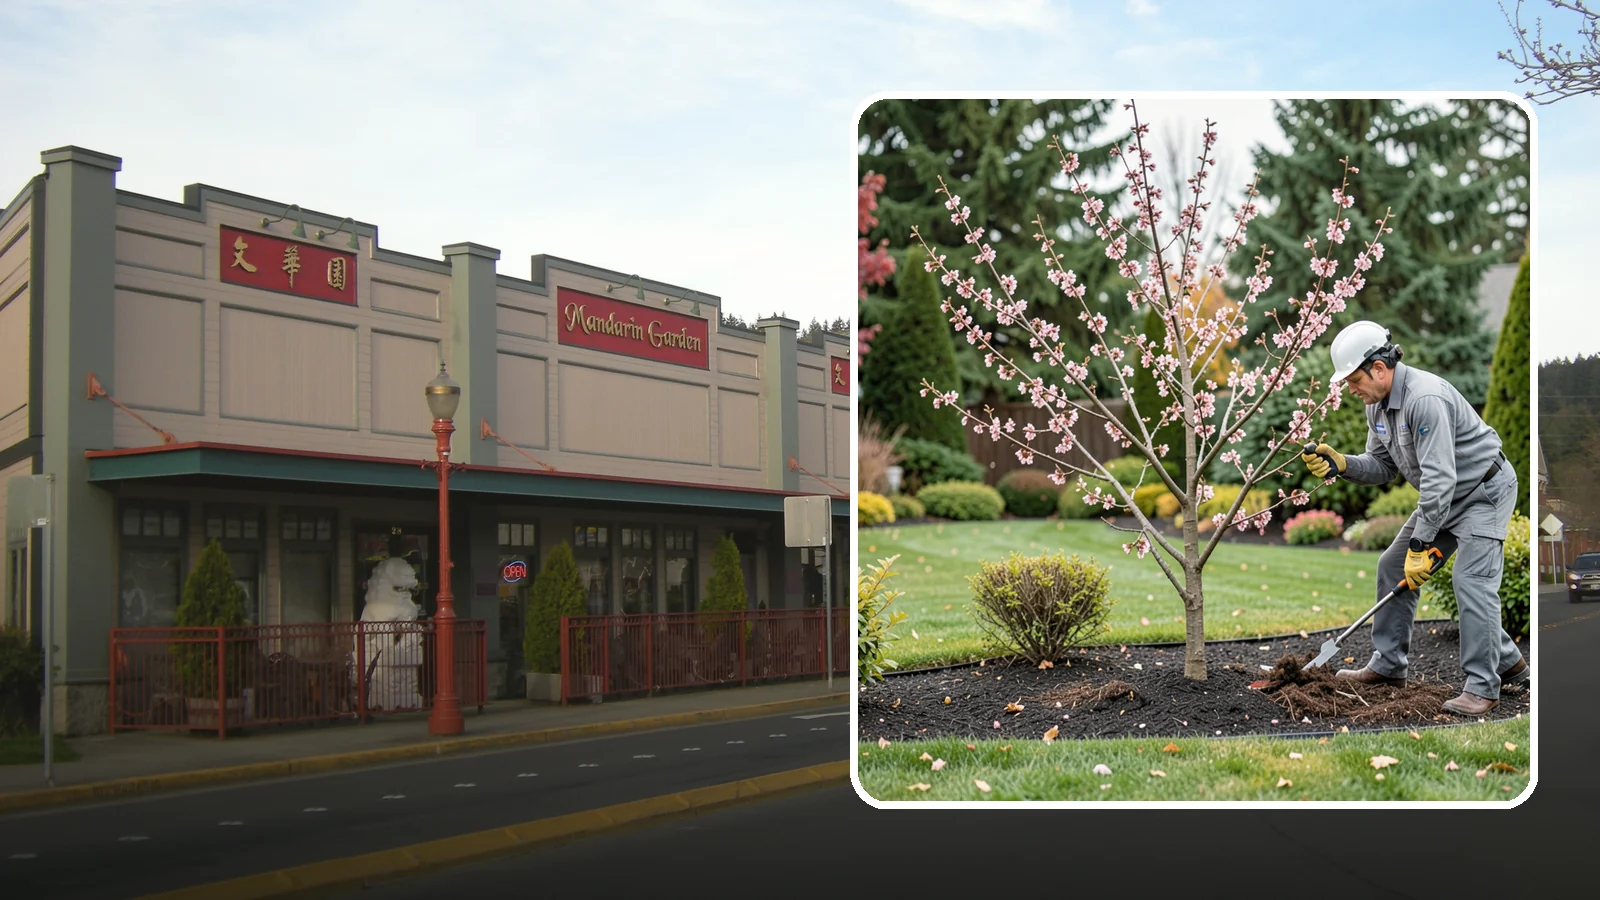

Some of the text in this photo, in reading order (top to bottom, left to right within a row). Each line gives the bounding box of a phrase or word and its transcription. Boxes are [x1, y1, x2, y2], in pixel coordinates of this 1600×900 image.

[231, 236, 346, 290] 文華園
[564, 302, 701, 352] Mandarin Garden
[503, 565, 527, 578] OPEN
